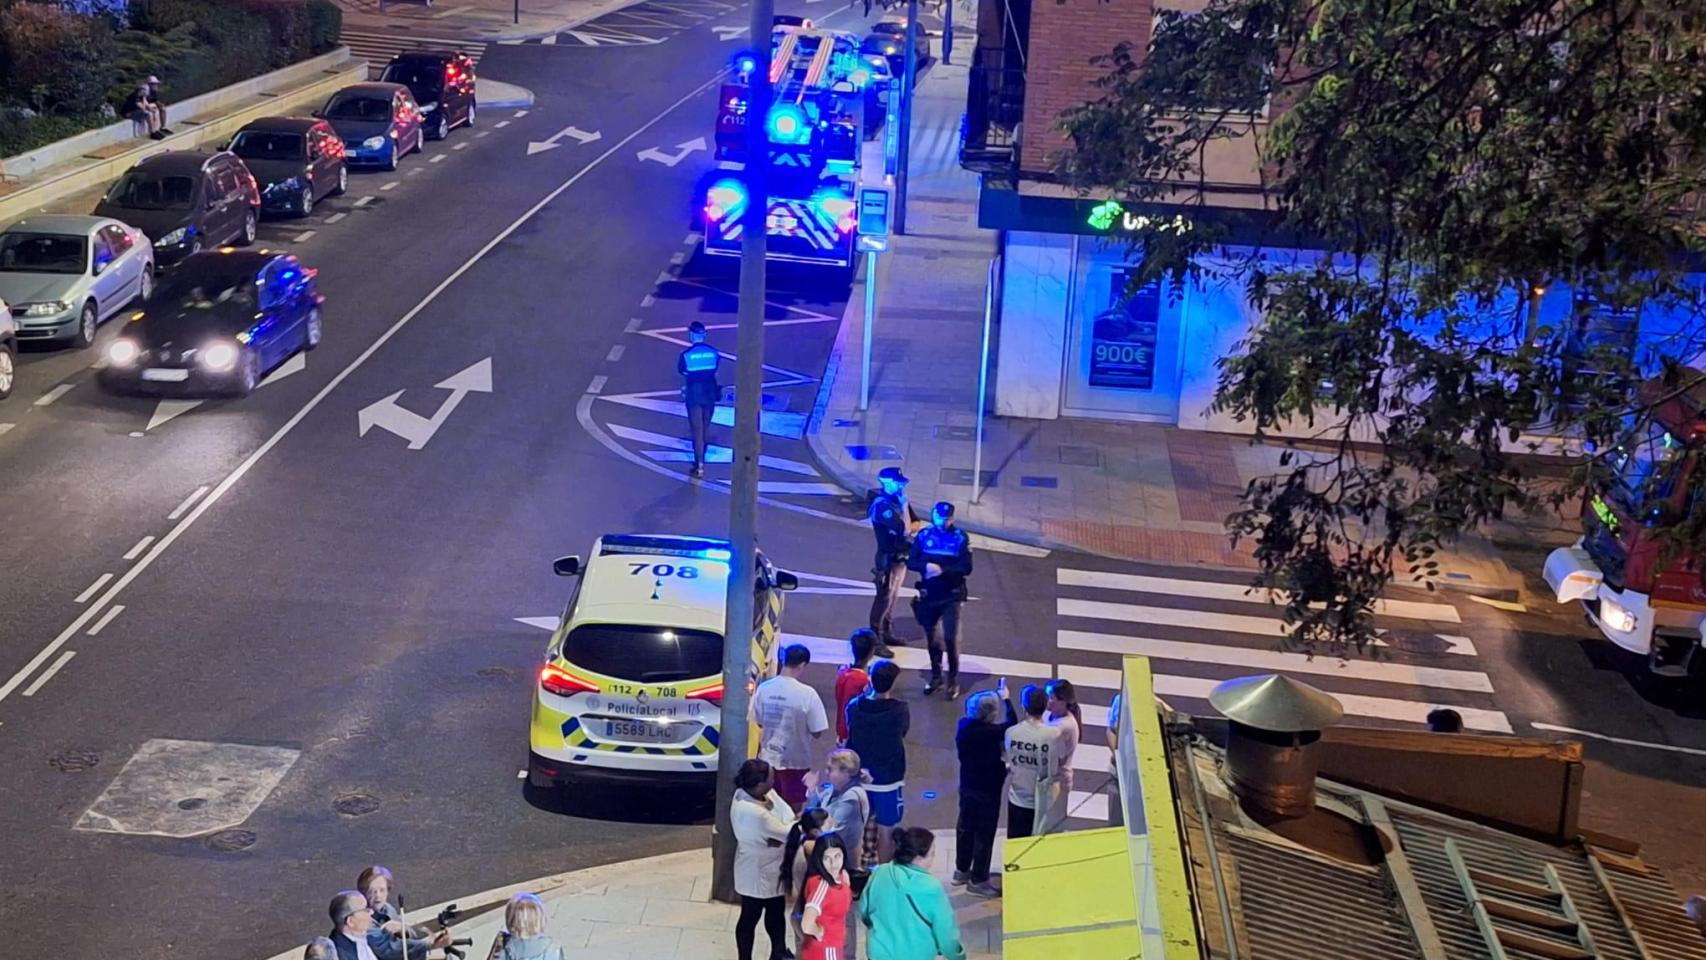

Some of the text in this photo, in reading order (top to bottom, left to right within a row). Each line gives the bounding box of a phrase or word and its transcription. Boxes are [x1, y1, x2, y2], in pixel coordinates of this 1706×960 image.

[1096, 345, 1147, 363] 900€
[628, 563, 698, 579] 708
[613, 685, 631, 694] 112
[656, 687, 677, 697] 708
